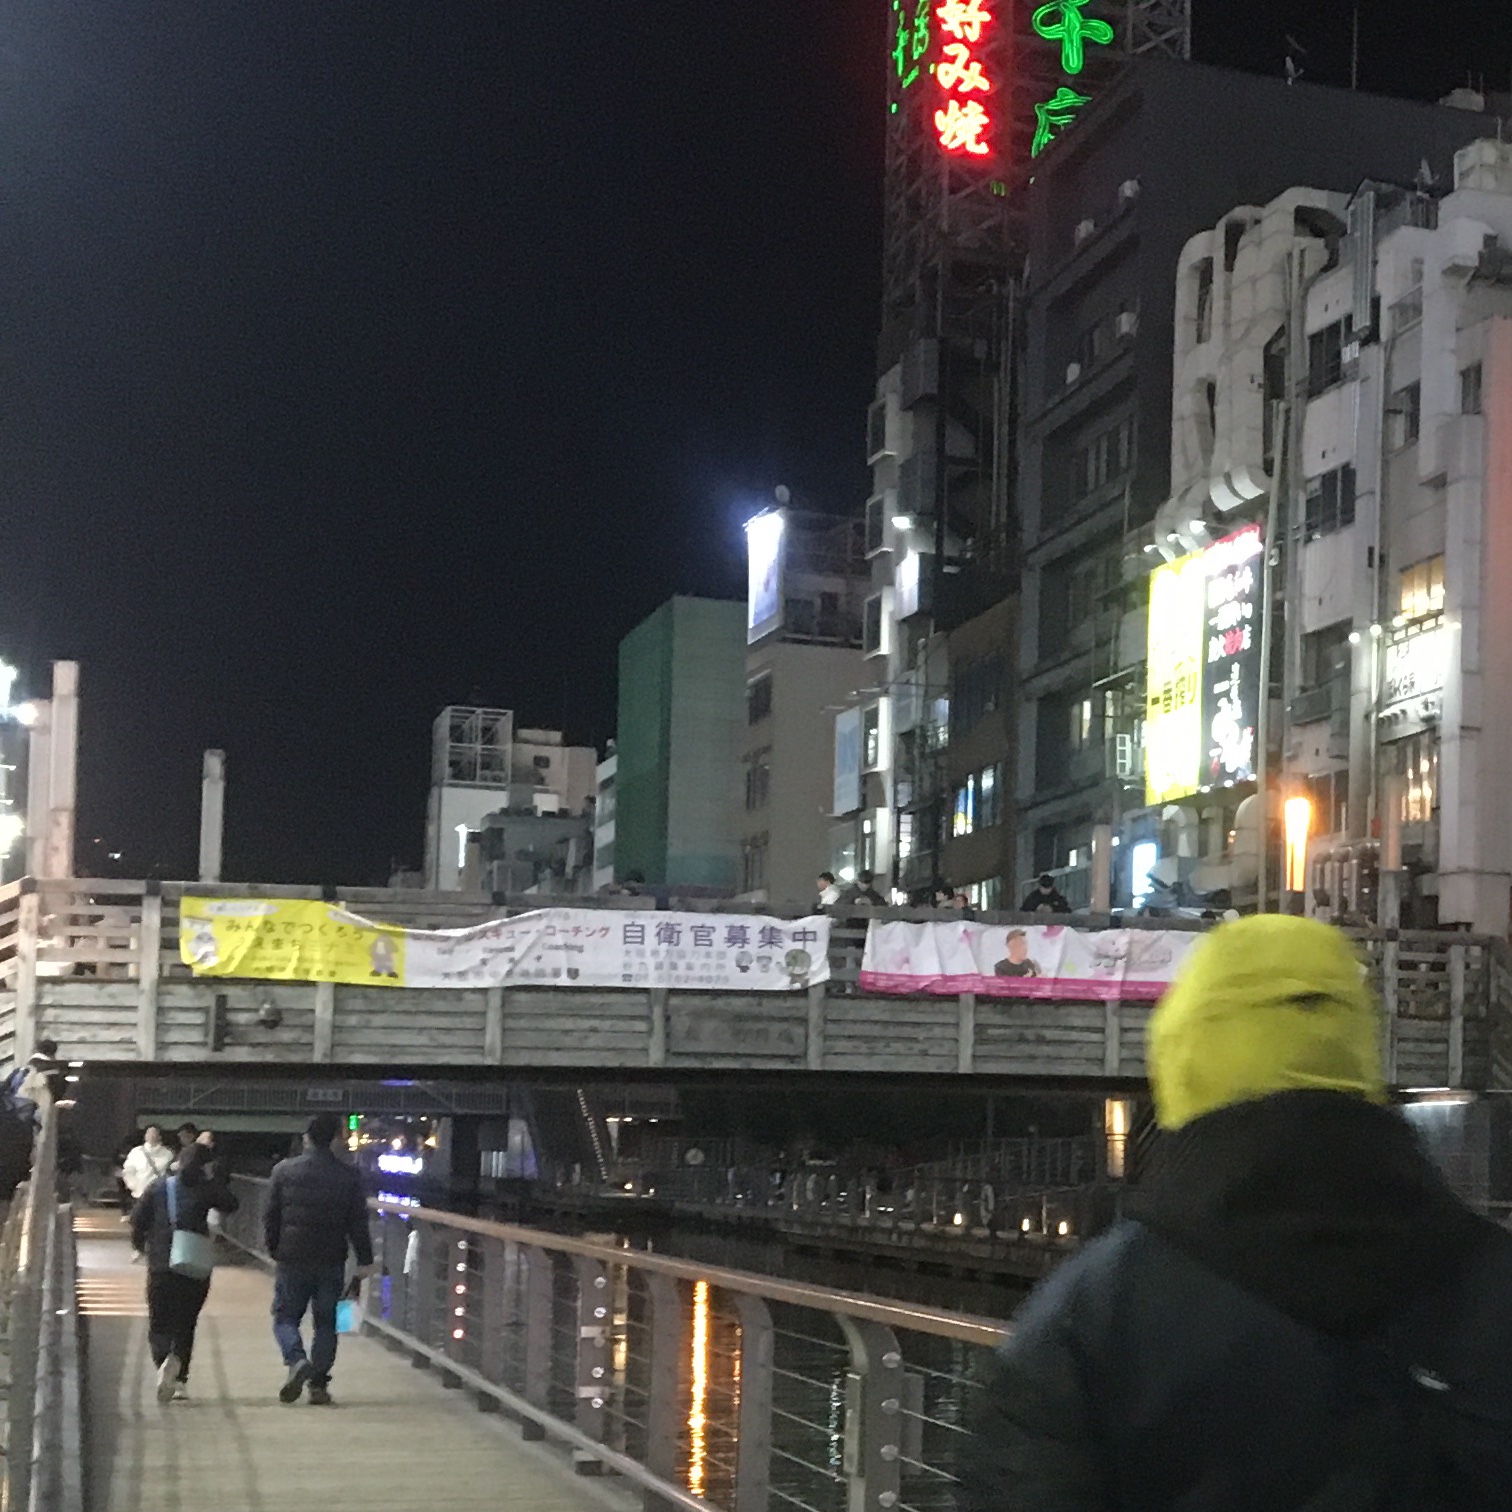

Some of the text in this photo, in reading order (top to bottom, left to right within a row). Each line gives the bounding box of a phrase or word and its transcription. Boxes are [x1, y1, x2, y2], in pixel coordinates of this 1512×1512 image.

[623, 920, 817, 950] 自衛官募集中
